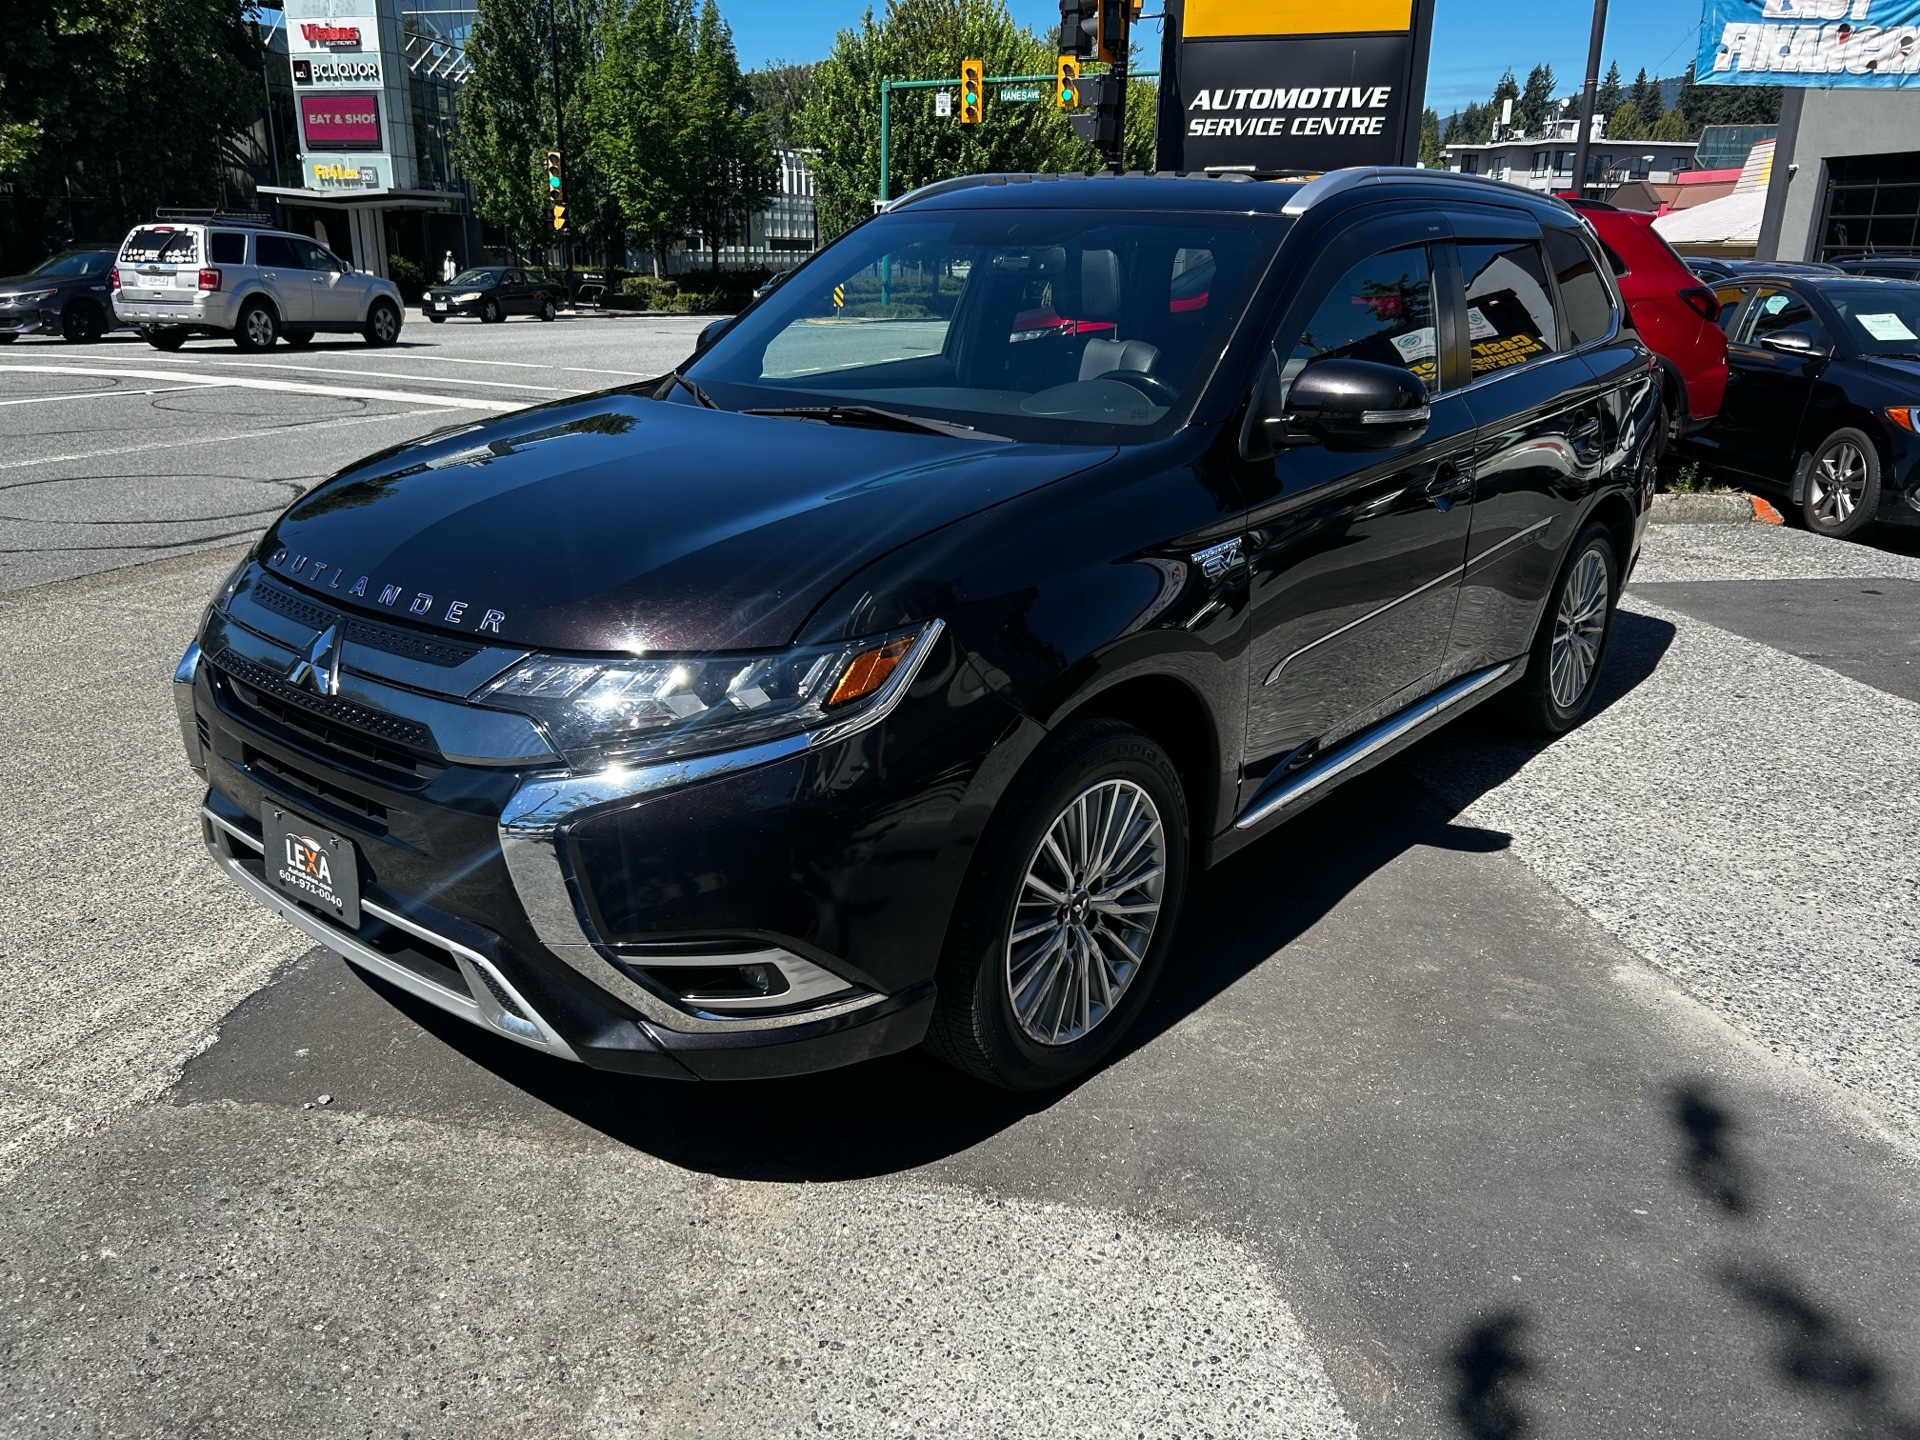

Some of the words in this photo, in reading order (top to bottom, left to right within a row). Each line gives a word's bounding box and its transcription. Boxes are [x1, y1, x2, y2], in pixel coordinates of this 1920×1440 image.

[300, 23, 359, 41] Visions
[1000, 90, 1028, 101] HANES
[1027, 91, 1040, 99] AVE
[1188, 86, 1392, 111] AUTOMOTIVE
[309, 114, 331, 124] EAT
[334, 114, 344, 124] &
[1188, 117, 1286, 137] SERVICE
[1290, 116, 1386, 136] CENTRE
[272, 547, 506, 634] OUTLANDER
[285, 838, 332, 884] LEXA
[278, 869, 343, 908] 604-971-0040
